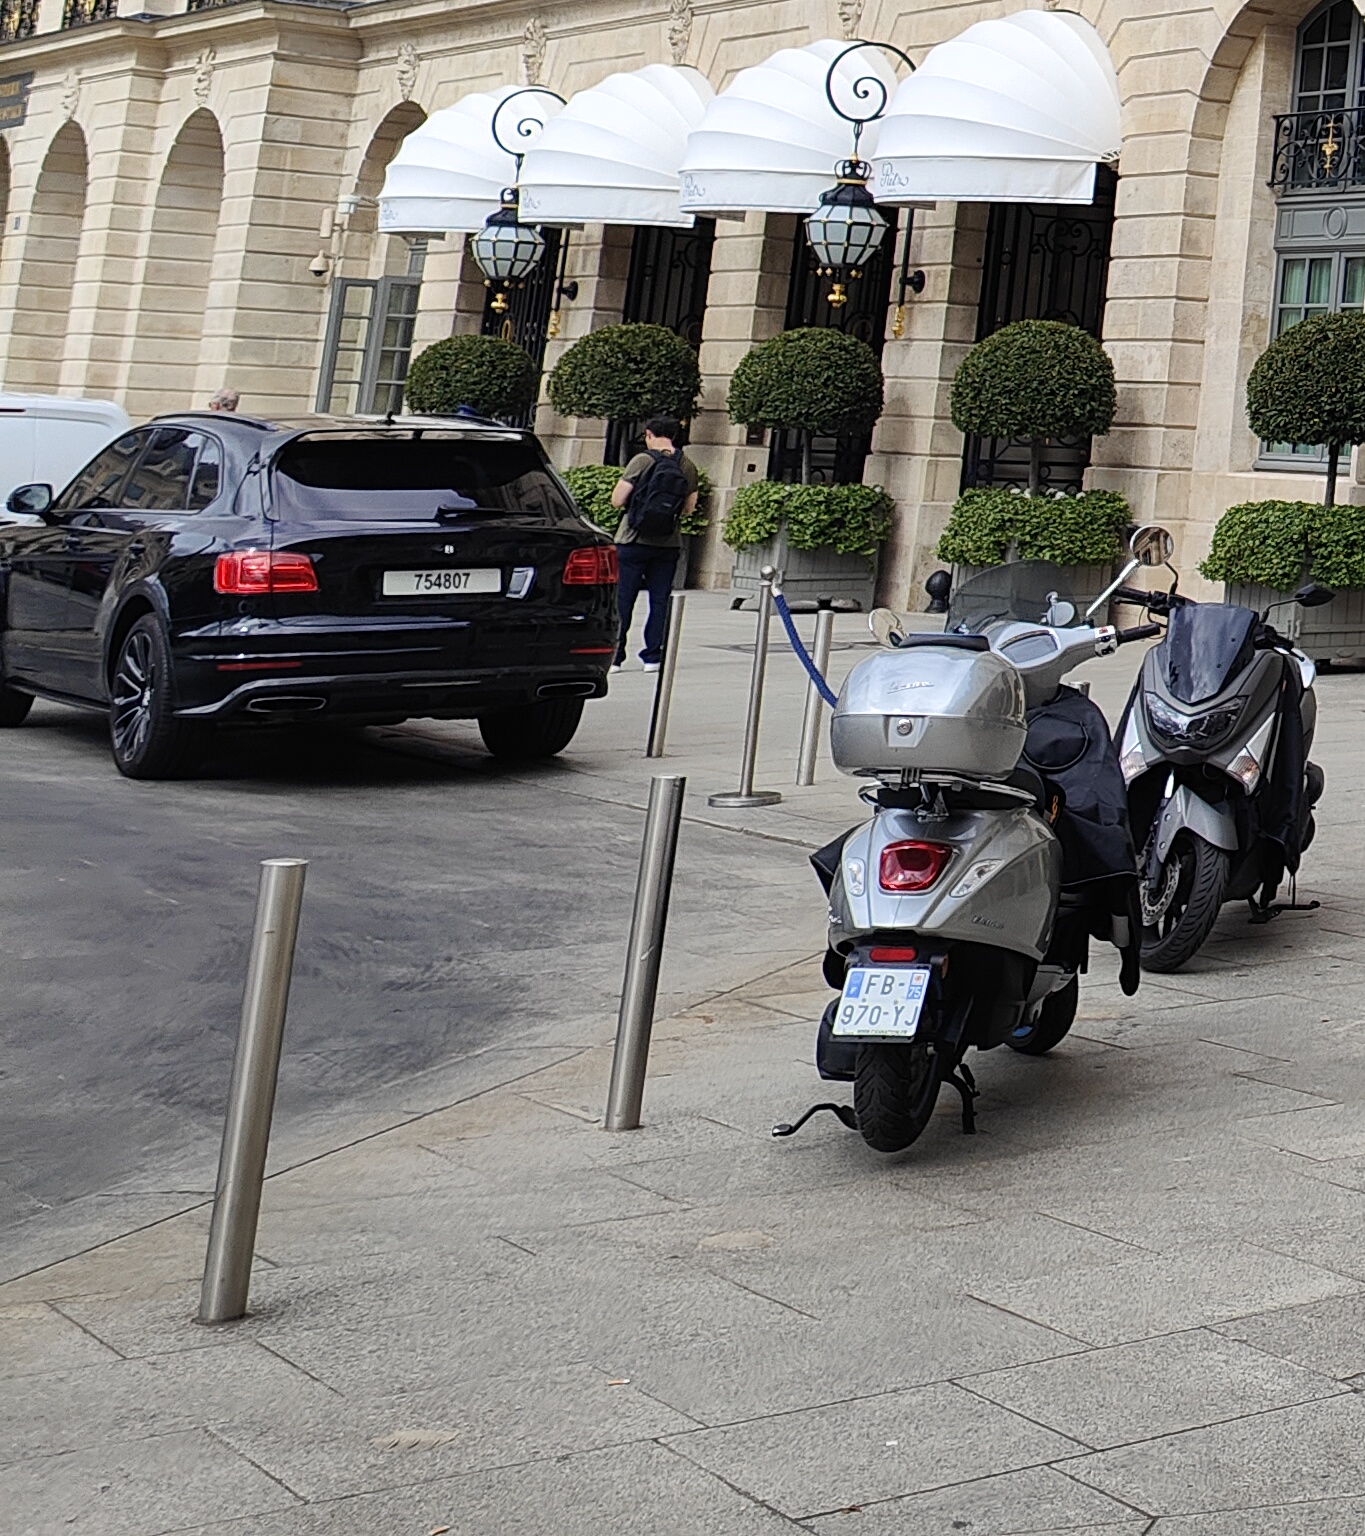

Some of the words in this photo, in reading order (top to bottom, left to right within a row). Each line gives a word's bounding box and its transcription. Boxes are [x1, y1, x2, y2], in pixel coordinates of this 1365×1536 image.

[414, 572, 470, 590] 754807
[908, 987, 921, 998] 75
[840, 1005, 919, 1026] 970-YJ
